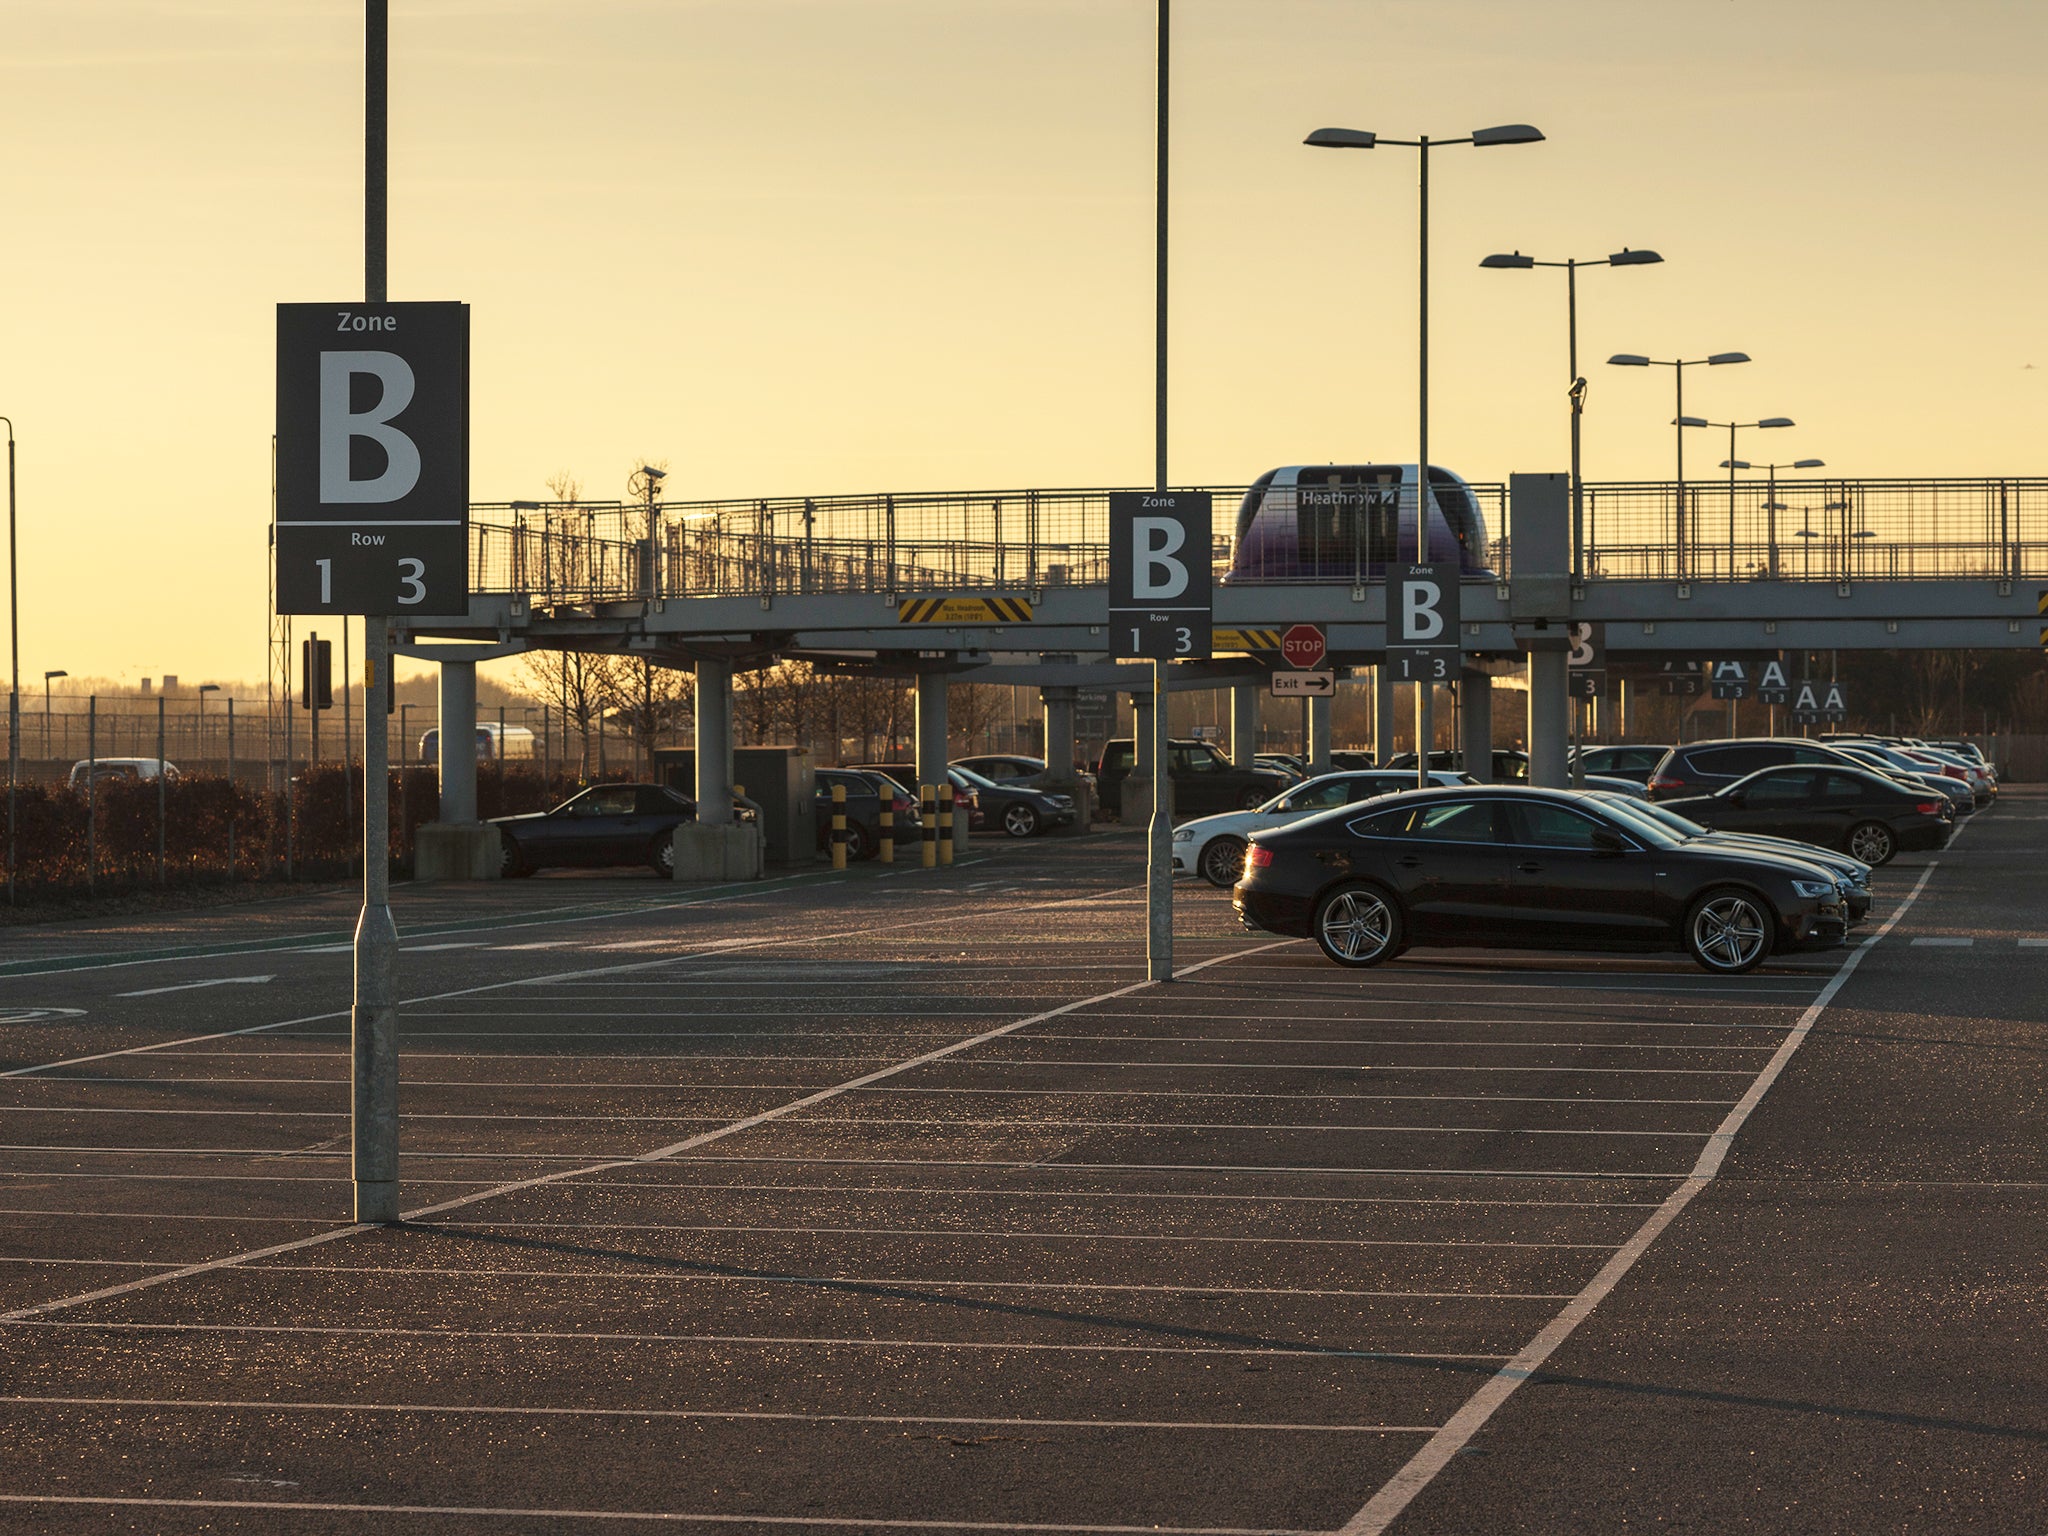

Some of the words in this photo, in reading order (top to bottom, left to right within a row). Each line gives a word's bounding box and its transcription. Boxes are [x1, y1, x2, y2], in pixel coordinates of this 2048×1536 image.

[337, 312, 397, 332] Zone
[320, 351, 421, 503] B
[1142, 496, 1175, 507] Zone
[351, 532, 386, 546] Row
[1133, 517, 1189, 599] B
[1409, 566, 1434, 575] Zone
[316, 559, 331, 603] 1
[397, 557, 426, 605] 3
[1150, 614, 1169, 622] Row
[1403, 581, 1444, 640] B
[1131, 628, 1140, 653] 1
[1175, 627, 1192, 653] 3
[1285, 640, 1322, 652] STOP
[1567, 622, 1594, 665] B
[1402, 659, 1409, 677] 1
[1433, 659, 1446, 677] 3
[1761, 661, 1786, 687] A
[1275, 679, 1298, 688] Exit
[1586, 680, 1596, 694] 3
[1668, 681, 1673, 693] 1
[1687, 681, 1695, 693] 3
[1720, 687, 1724, 697] 1
[1736, 687, 1743, 697] 3
[1778, 694, 1785, 703] 3
[1795, 686, 1818, 709] A
[1824, 688, 1844, 709] A
